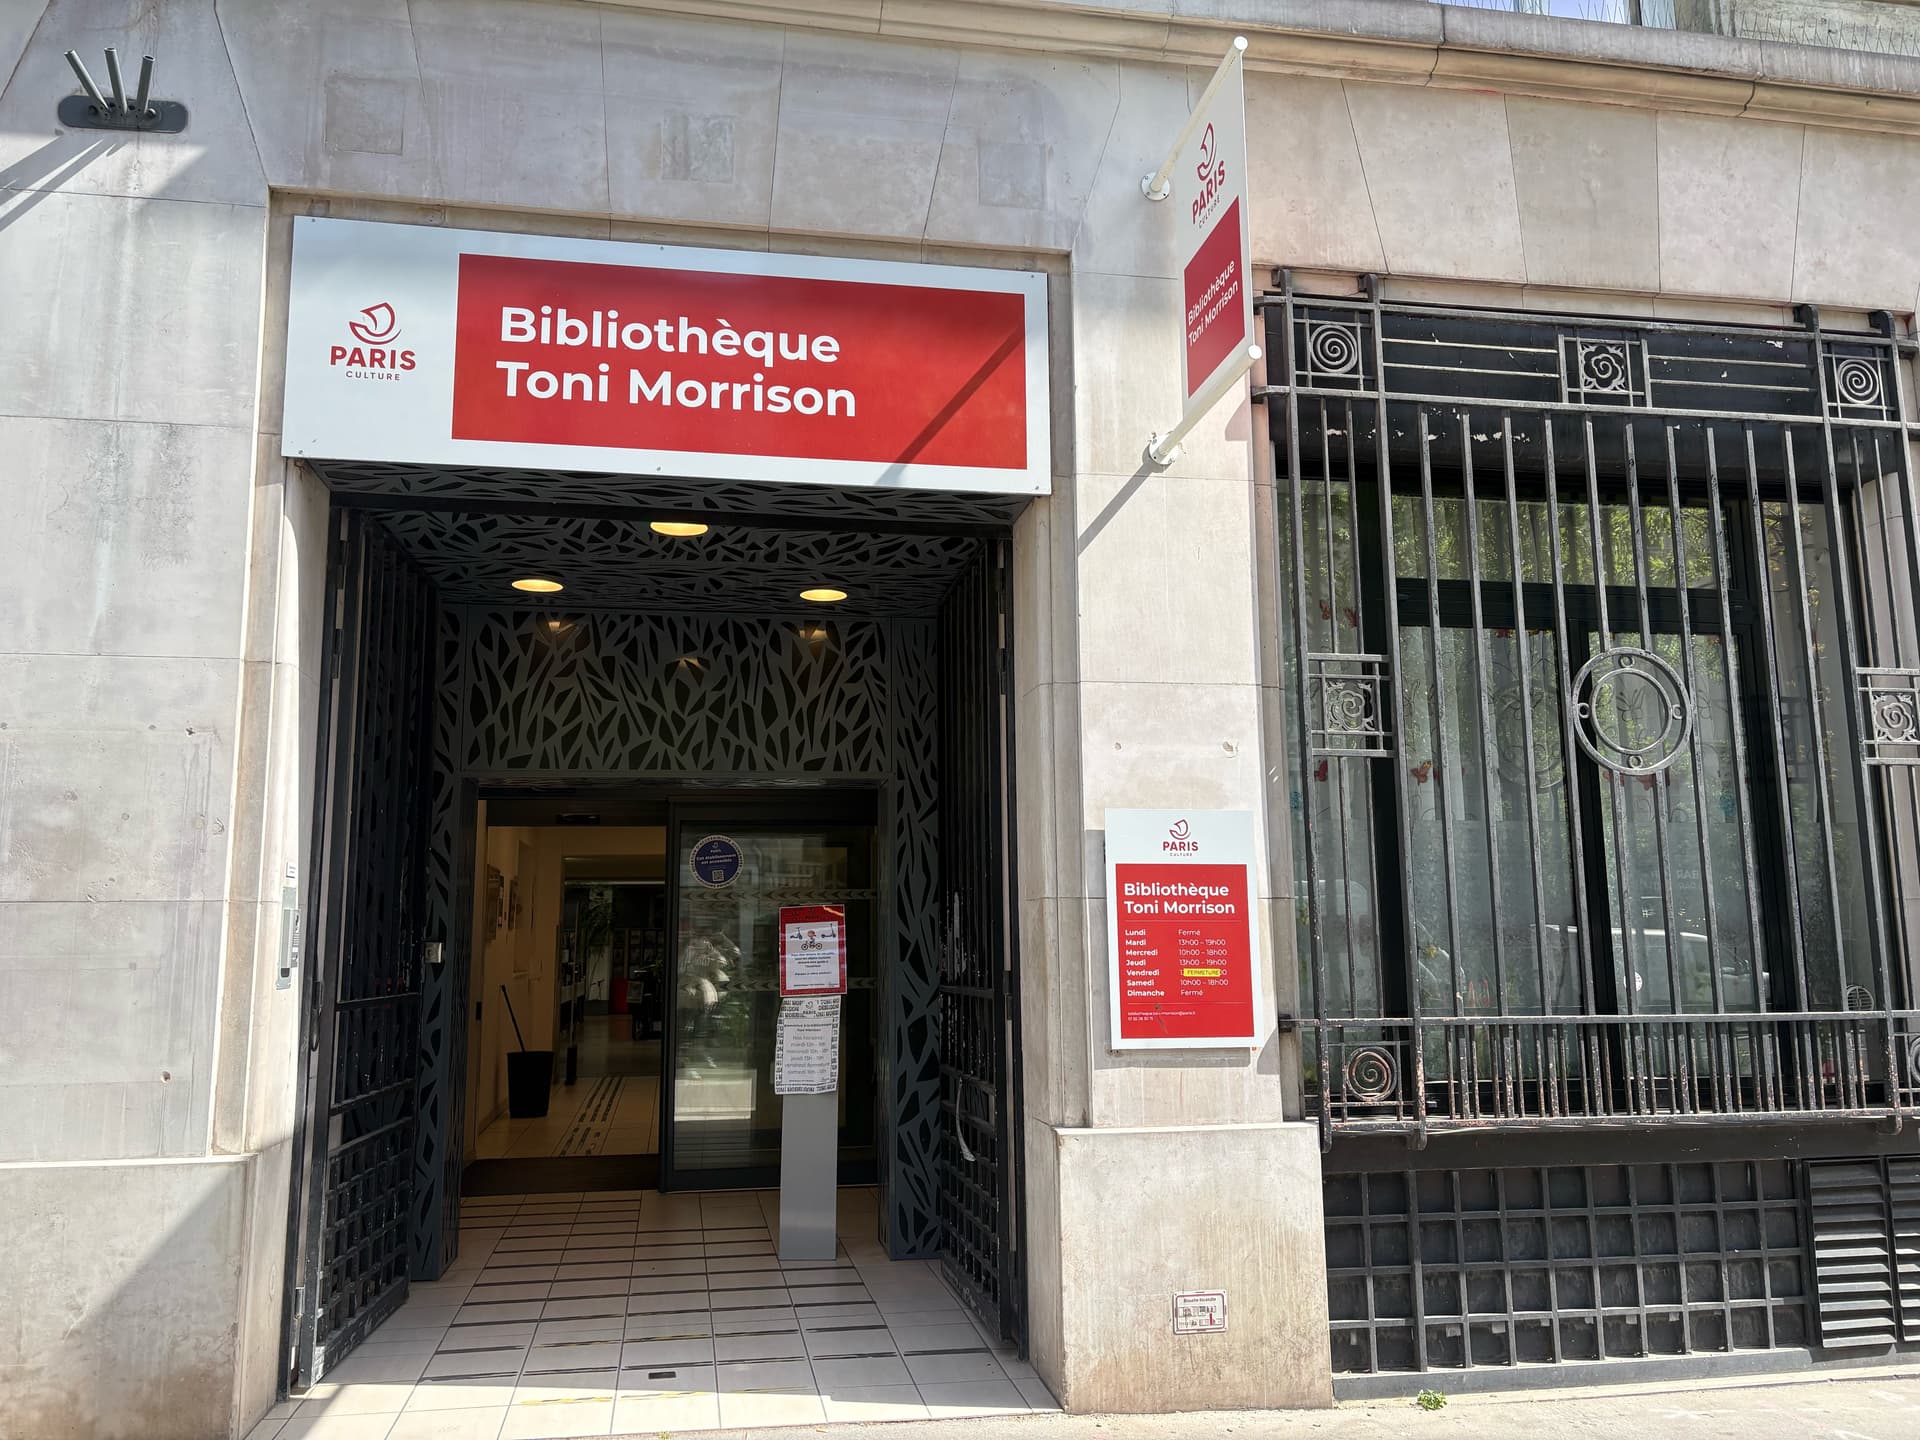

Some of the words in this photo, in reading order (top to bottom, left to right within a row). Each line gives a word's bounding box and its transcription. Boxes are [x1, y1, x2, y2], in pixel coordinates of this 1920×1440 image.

[1192, 160, 1225, 225] PARIS
[1188, 260, 1235, 326] Bibliothèque
[1188, 317, 1204, 347] Toni
[1204, 281, 1238, 328] Morrison
[500, 305, 841, 368] Bibliothèque
[330, 346, 416, 371] PARIS
[345, 371, 401, 381] CULTURE
[496, 360, 610, 403] Toni
[628, 367, 857, 418] Morrison
[1163, 841, 1199, 852] PARIS
[1123, 883, 1230, 899] Bibliothèque
[1124, 901, 1159, 914] Toni
[1163, 901, 1236, 914] Morrison
[1127, 989, 1165, 997] Dimanche
